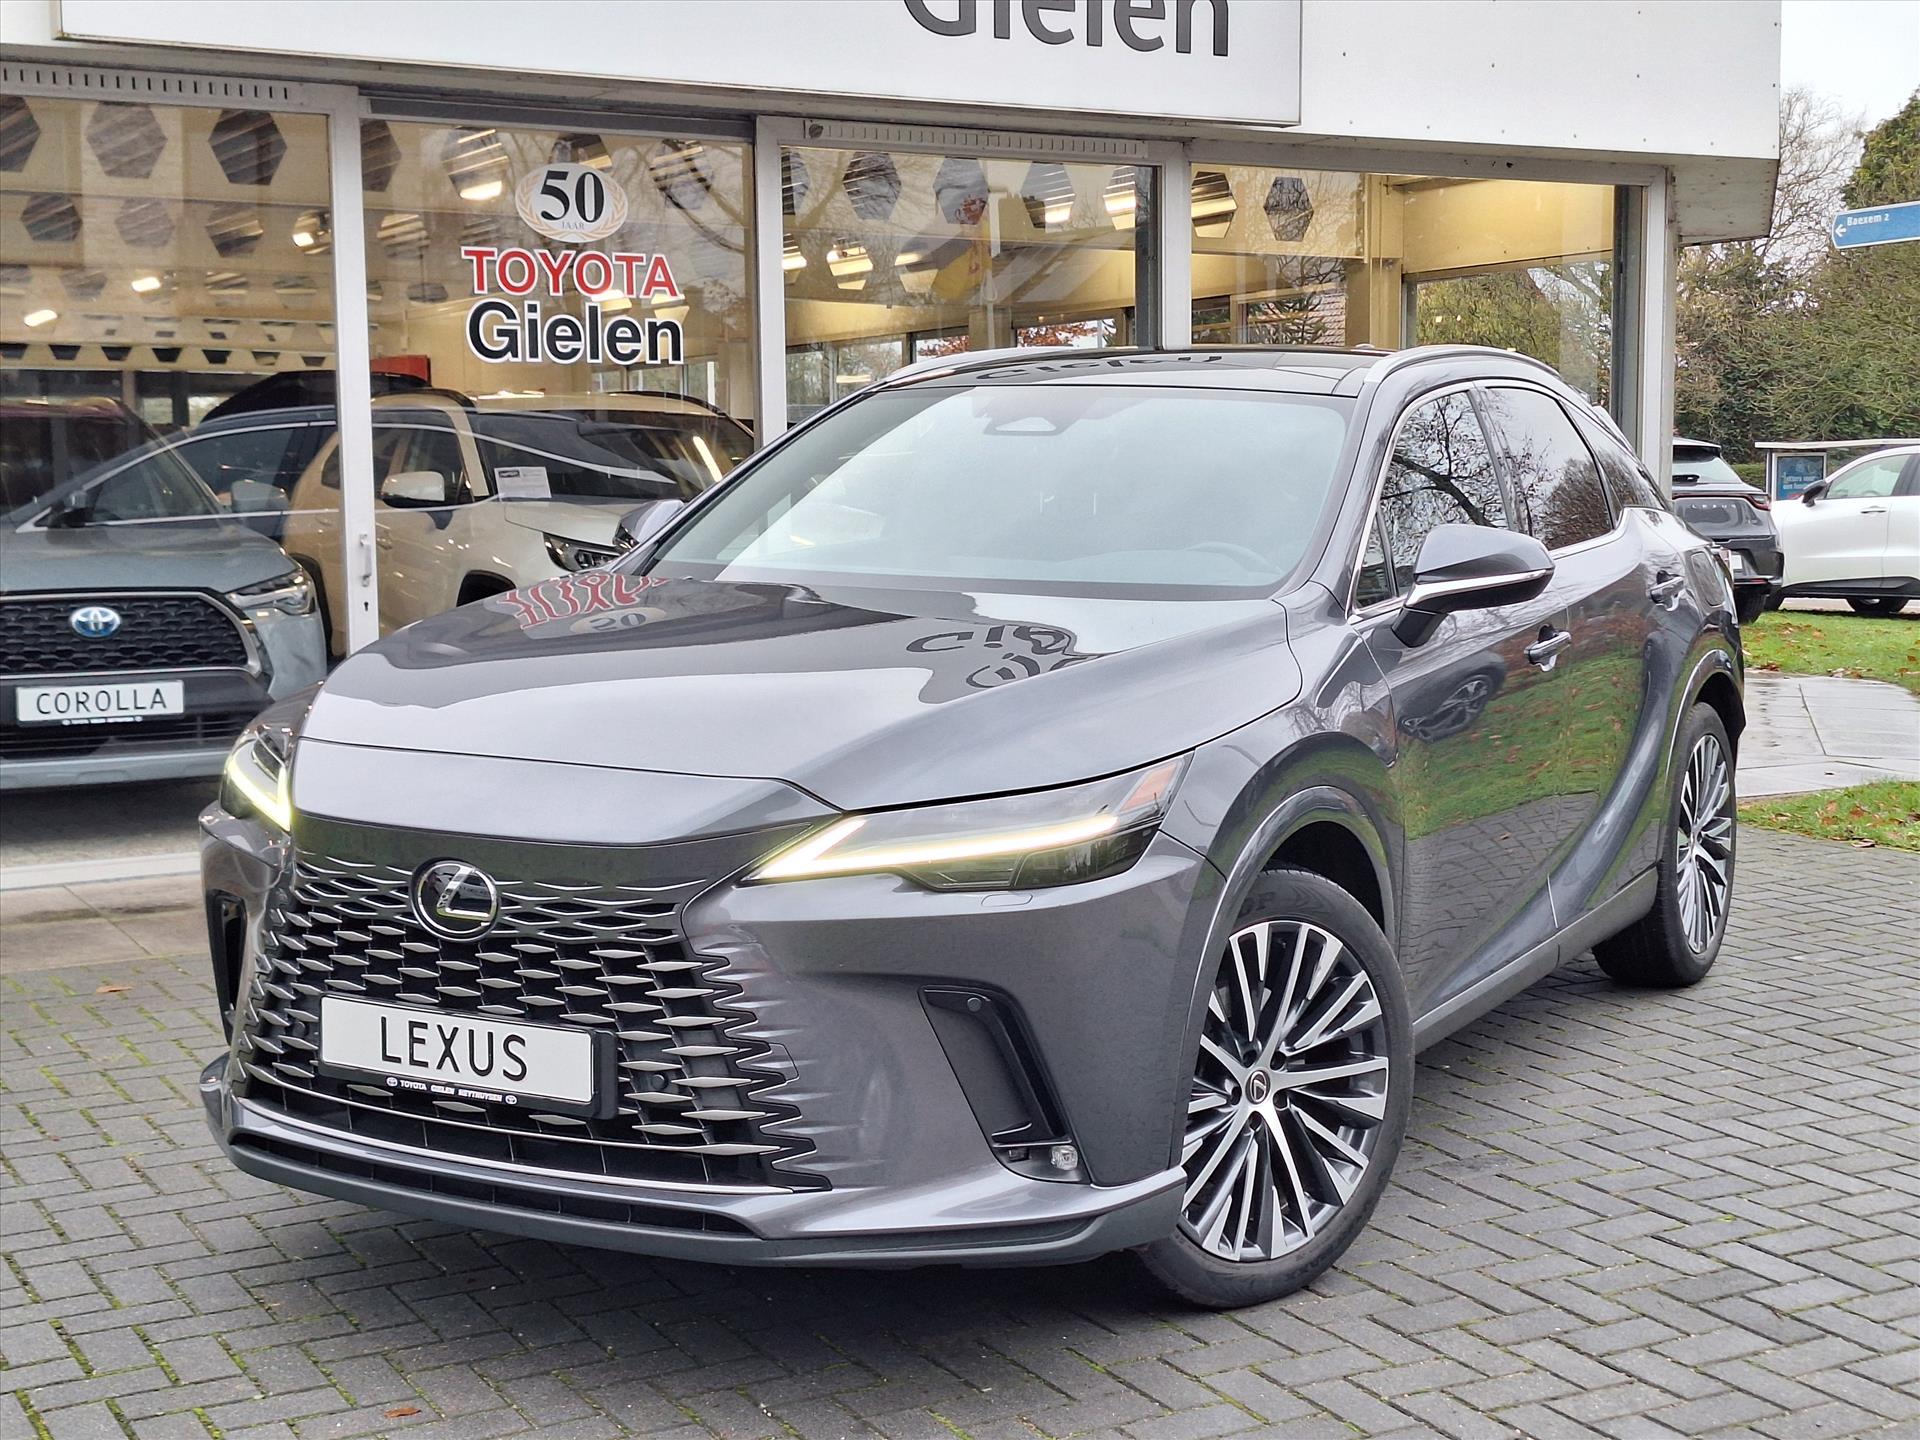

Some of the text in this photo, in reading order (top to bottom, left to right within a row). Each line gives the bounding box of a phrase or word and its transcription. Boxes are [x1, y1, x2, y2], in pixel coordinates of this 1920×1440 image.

[540, 170, 605, 223] 50
[1847, 213, 1890, 226] Baexem 2
[462, 247, 681, 298] TOYOTA
[467, 299, 683, 364] Gielen
[36, 688, 167, 715] COROLLA
[381, 1016, 528, 1082] LEXUS
[400, 1080, 427, 1091] TOYOTA
